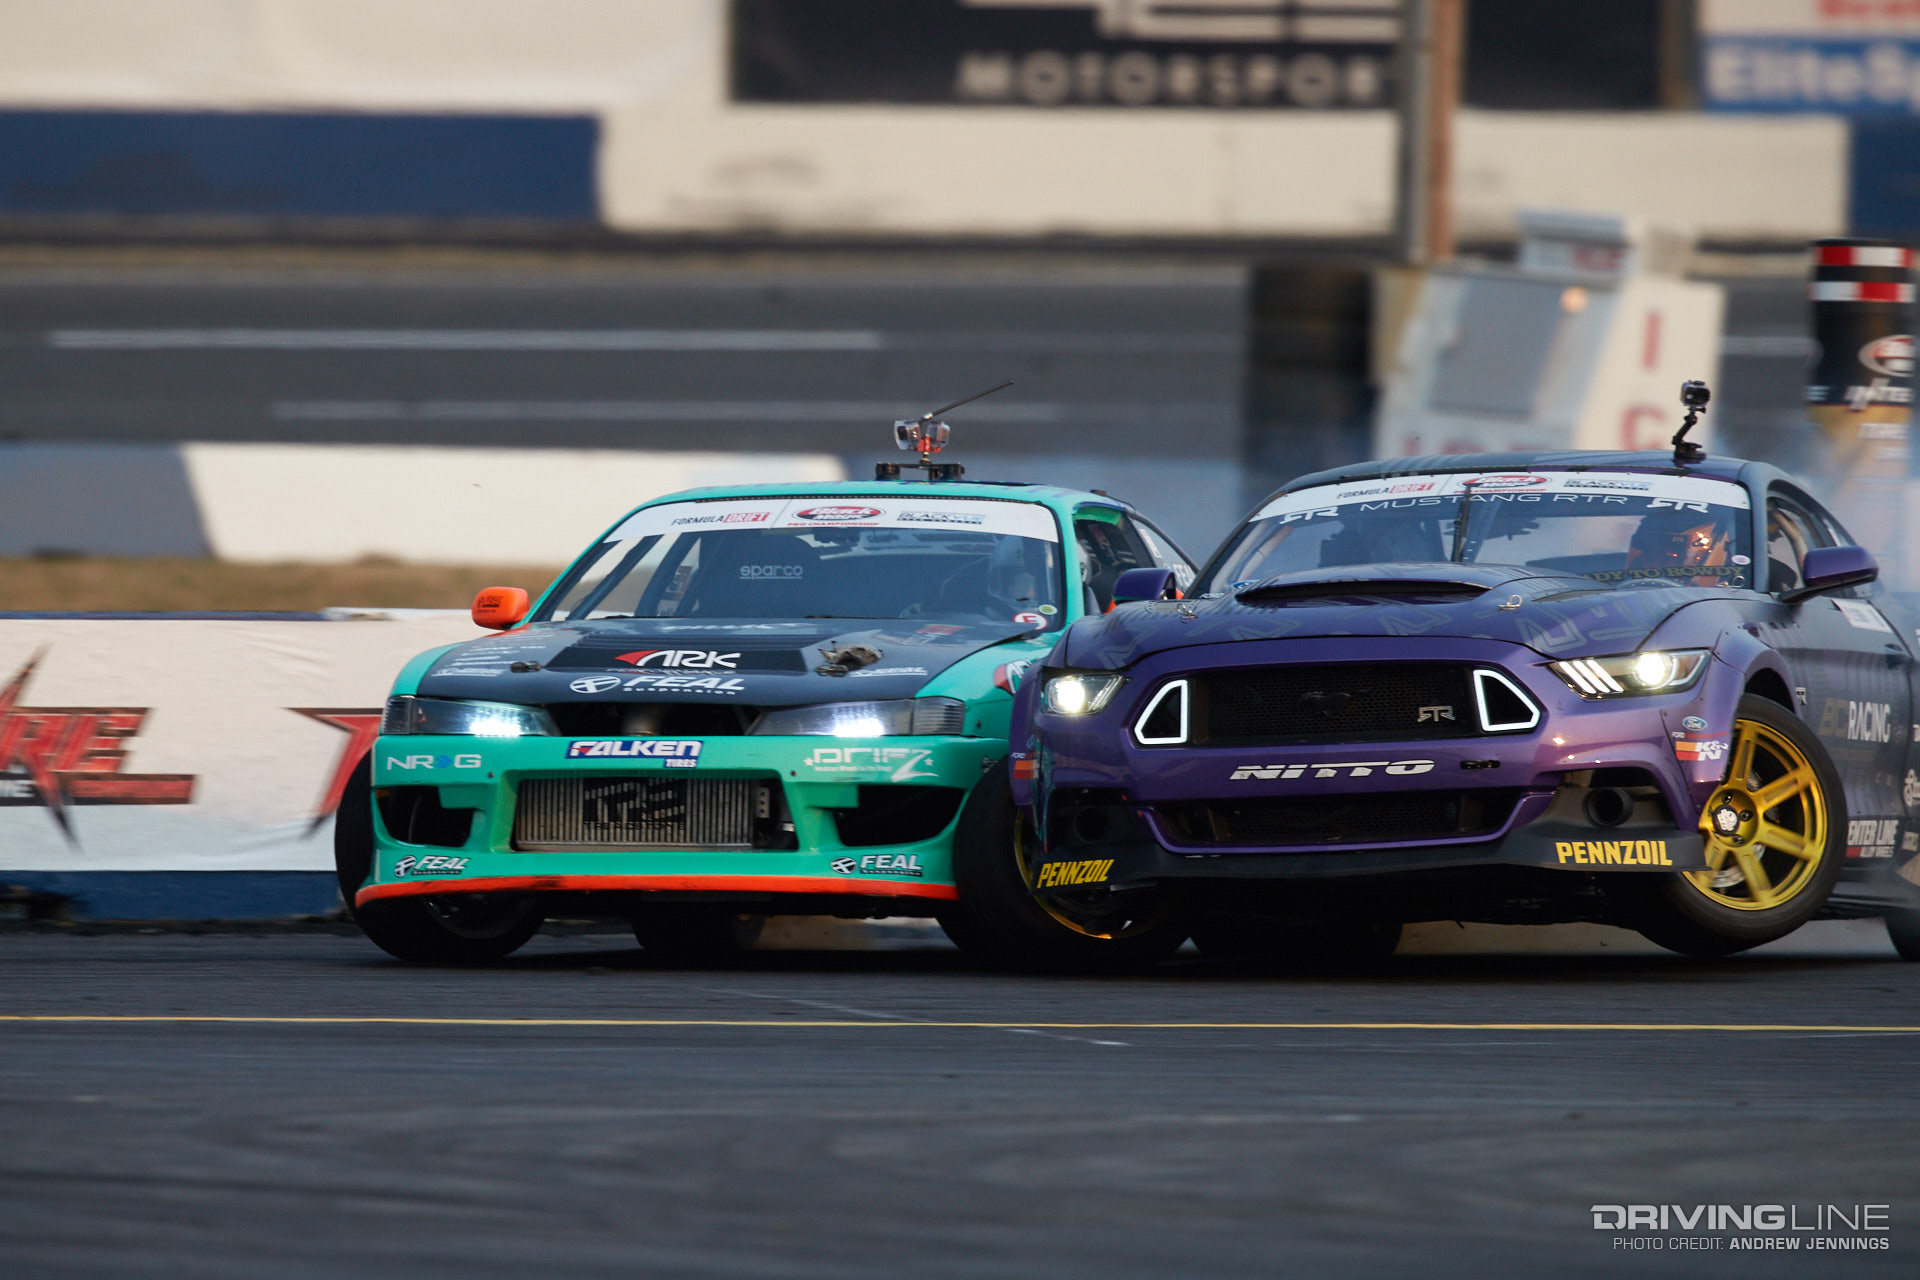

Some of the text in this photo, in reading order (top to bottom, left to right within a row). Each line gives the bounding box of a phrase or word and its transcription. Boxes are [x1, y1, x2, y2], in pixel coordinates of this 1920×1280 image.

[1337, 483, 1435, 499] FORMULA DRIFT
[1360, 493, 1628, 512] MUSTANG RTR
[808, 507, 871, 515] Black
[671, 512, 770, 526] FORMULA DRIFT
[740, 565, 803, 580] sparco
[1629, 569, 1660, 579] TO
[1665, 566, 1744, 577] ROWDY
[623, 676, 745, 690] FEAL
[622, 687, 736, 695] Suspension
[1847, 701, 1891, 743] RACING
[569, 741, 702, 756] FALKEN
[665, 759, 696, 768] TIRES
[1229, 759, 1435, 780] NITTO
[1555, 840, 1672, 866] PENNZOIL
[414, 855, 470, 869] FEAL
[860, 855, 922, 870] FEAL
[1037, 859, 1114, 888] PENNZOIL
